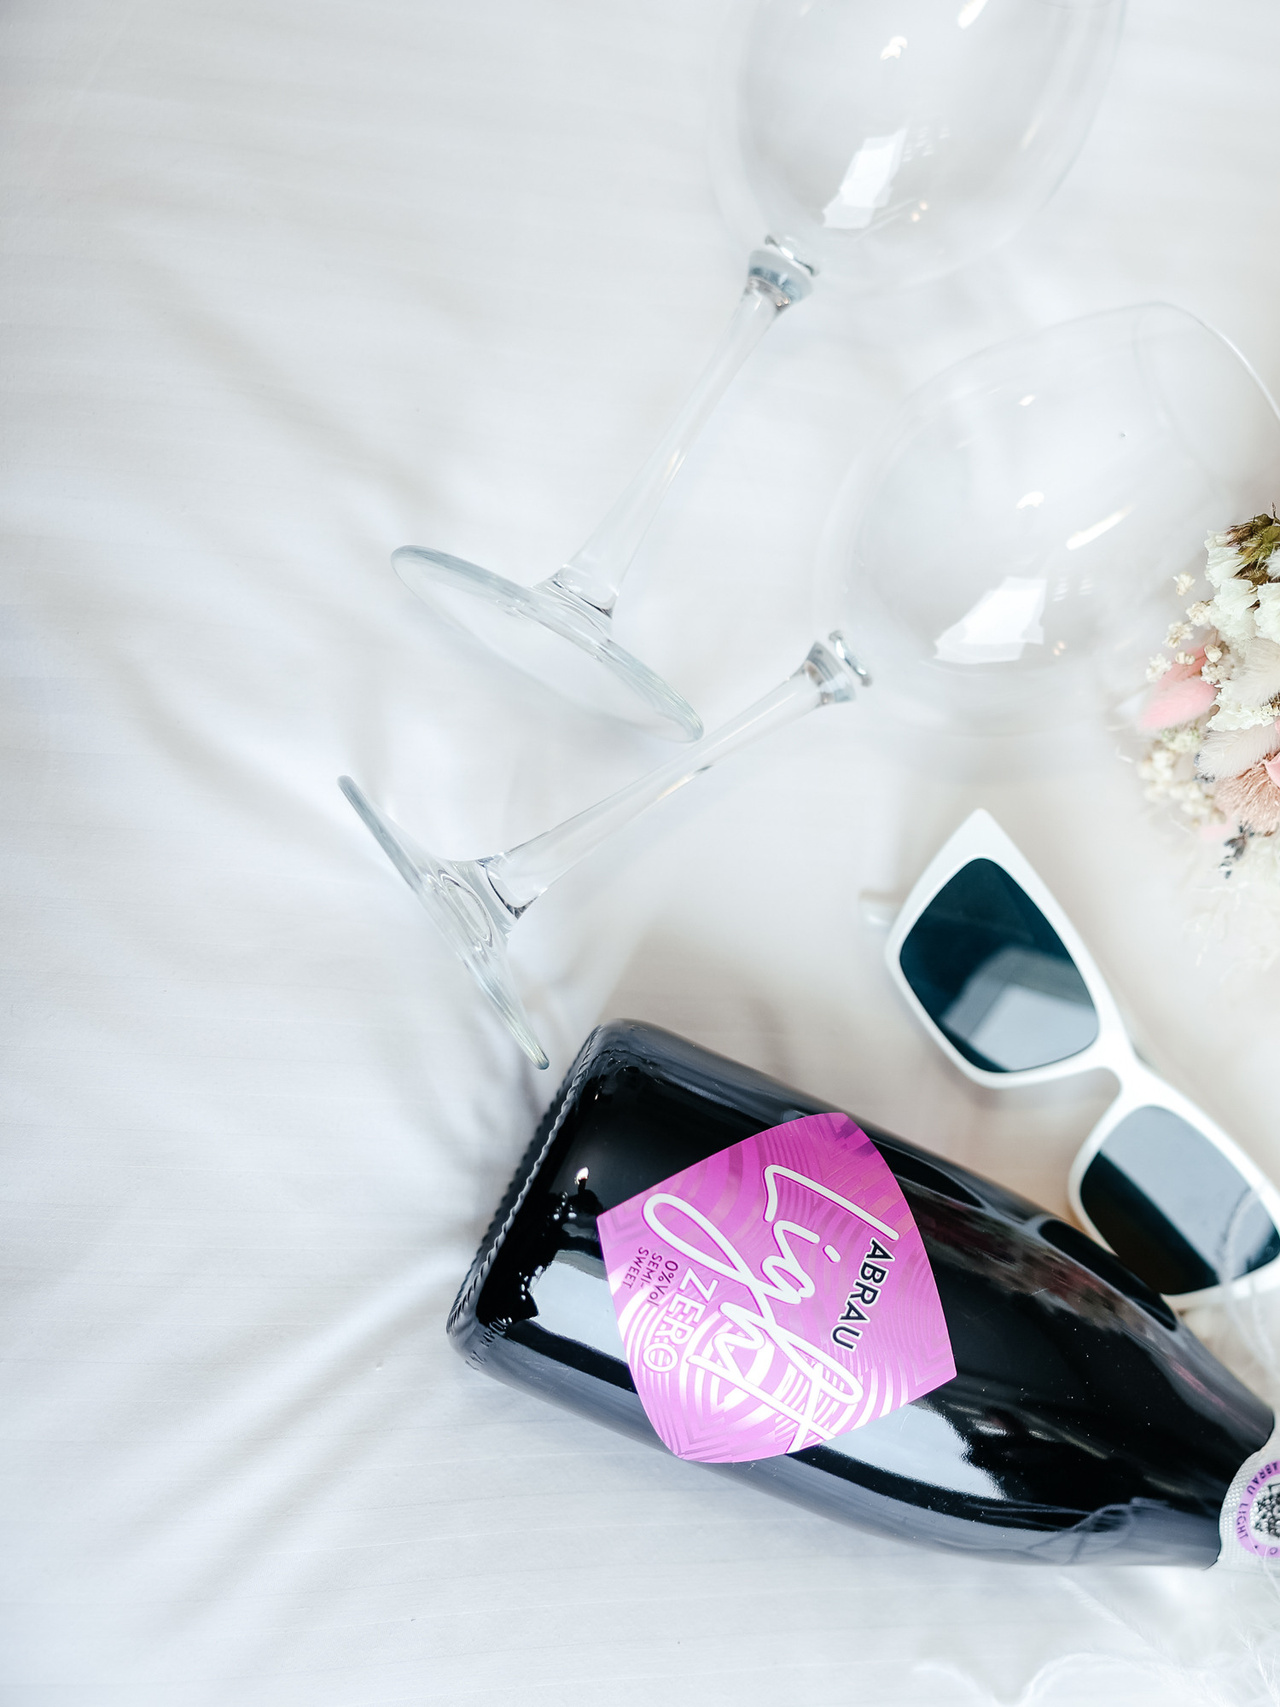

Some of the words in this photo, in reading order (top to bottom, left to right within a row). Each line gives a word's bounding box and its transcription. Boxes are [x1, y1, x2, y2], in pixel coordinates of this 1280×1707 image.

[622, 1246, 650, 1289] SWEET
[640, 1252, 663, 1288] SEMI-
[642, 1164, 900, 1454] Light
[831, 1237, 896, 1352] ABRAU
[642, 1267, 720, 1374] ZERO
[1246, 1462, 1279, 1495] ABRAU
[1236, 1502, 1249, 1539] LIGHT
